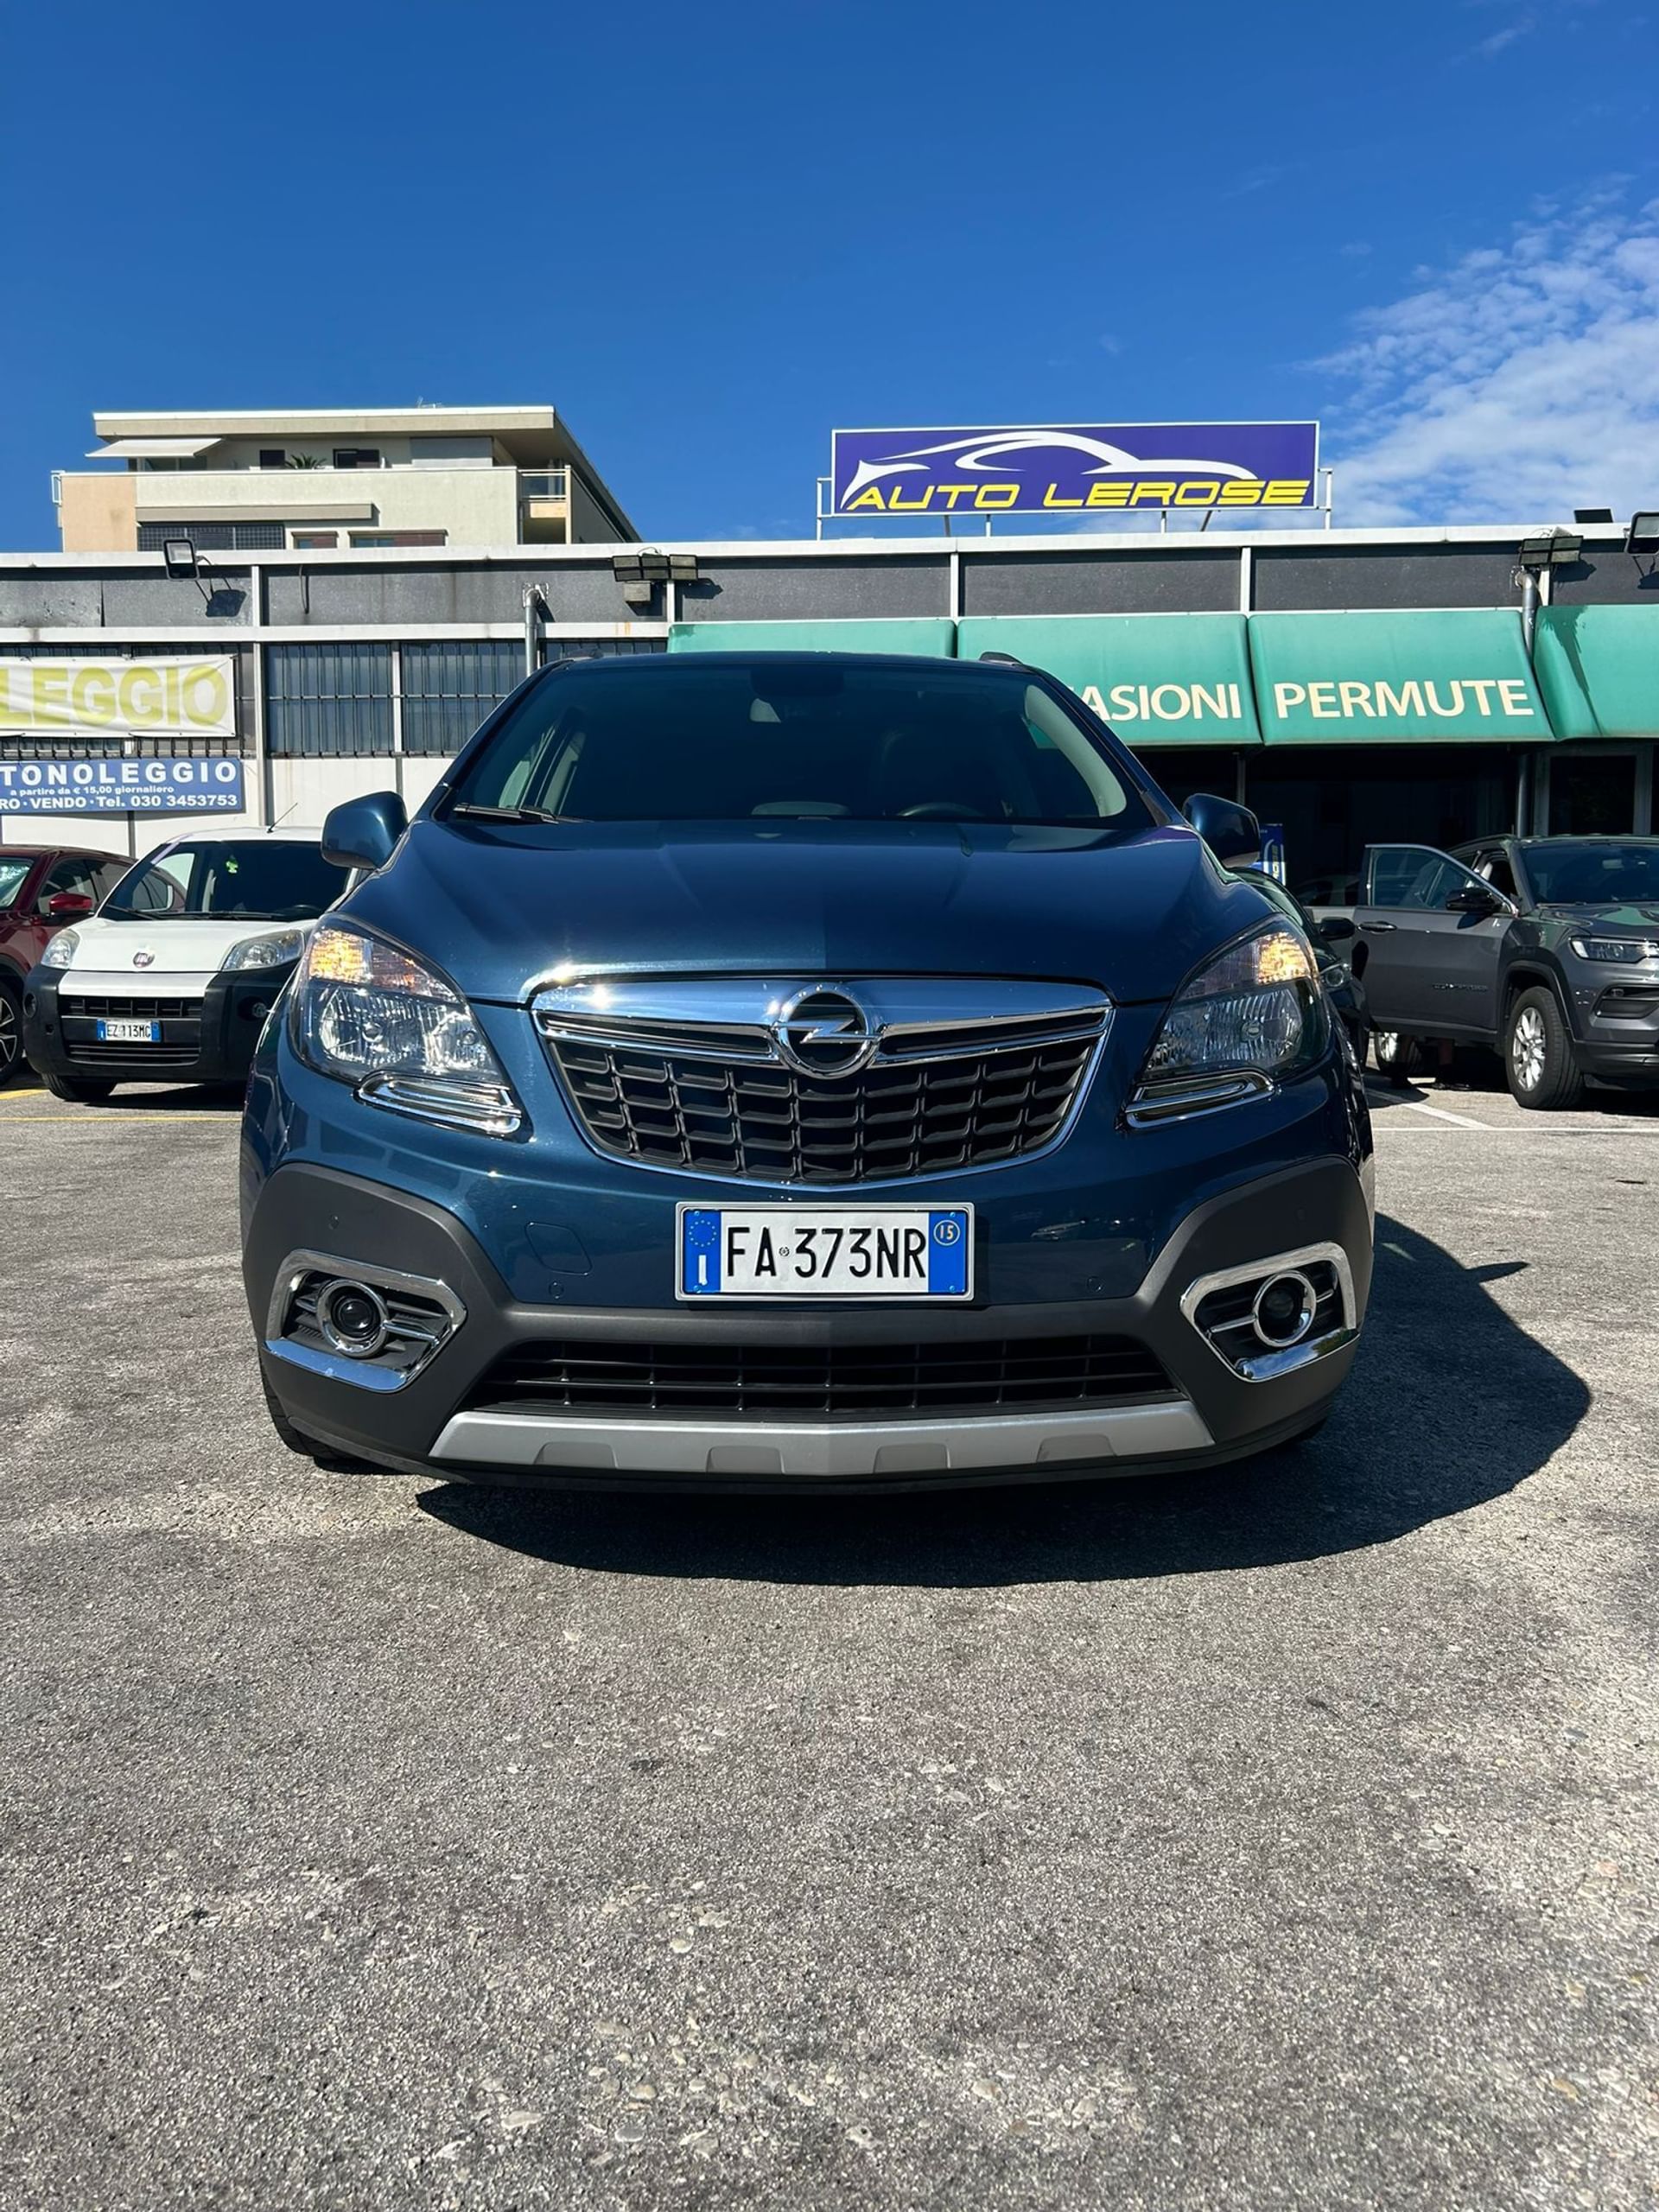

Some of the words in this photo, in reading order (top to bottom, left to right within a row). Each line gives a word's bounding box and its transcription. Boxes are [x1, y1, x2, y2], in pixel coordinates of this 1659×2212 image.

[847, 483, 1020, 510] AUTO
[1043, 480, 1310, 507] LEROSE
[1070, 683, 1242, 721] ASIONI
[1274, 679, 1535, 719] PERMUTE
[0, 761, 237, 786] TONOLEGGIO
[30, 797, 86, 809] VENDO
[96, 796, 126, 808] Tel.
[130, 795, 162, 807] 030
[167, 794, 238, 807] 3453753
[84, 785, 112, 795] 15,00
[939, 1224, 954, 1239] 15
